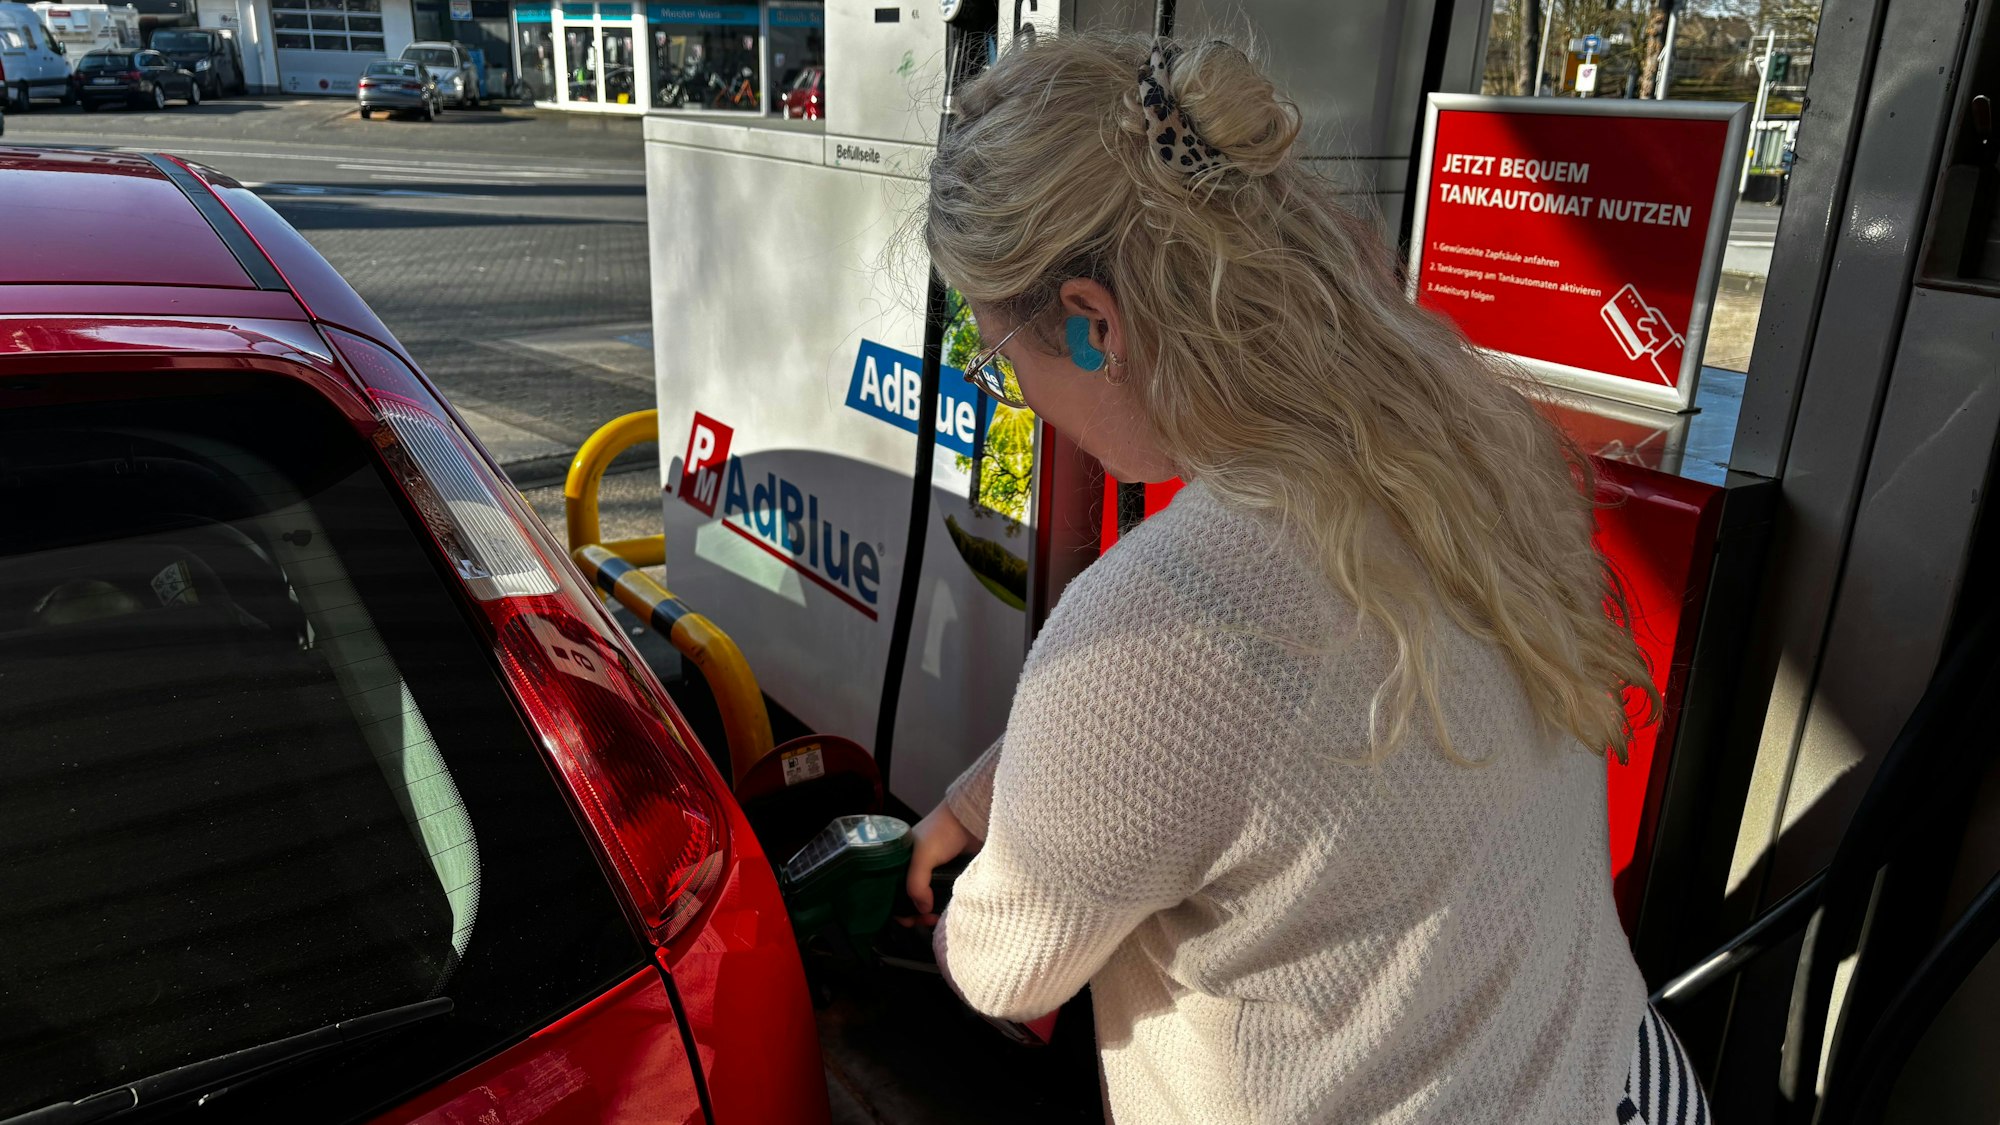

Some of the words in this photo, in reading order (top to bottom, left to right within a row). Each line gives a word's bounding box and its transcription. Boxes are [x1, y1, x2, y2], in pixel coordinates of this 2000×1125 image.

[836, 144, 880, 164] Befüllseite
[1442, 153, 1496, 176] JETZT
[1499, 157, 1590, 183] BEQUEM
[1440, 183, 1593, 217] TANKAUTOMAT
[1598, 199, 1692, 228] NUTZEN
[1439, 242, 1484, 257] Gewünschte
[1485, 248, 1522, 263] Zapfsäule
[1523, 255, 1560, 268] anfahren
[1434, 284, 1470, 300] Anleitung
[1470, 288, 1495, 302] folgen
[1437, 263, 1483, 280] Tankvorgang
[1484, 272, 1497, 280] am
[1498, 272, 1558, 290] Tankautomaten
[1559, 282, 1602, 297] aktivieren
[859, 355, 976, 444] AdBue
[687, 424, 716, 474] P
